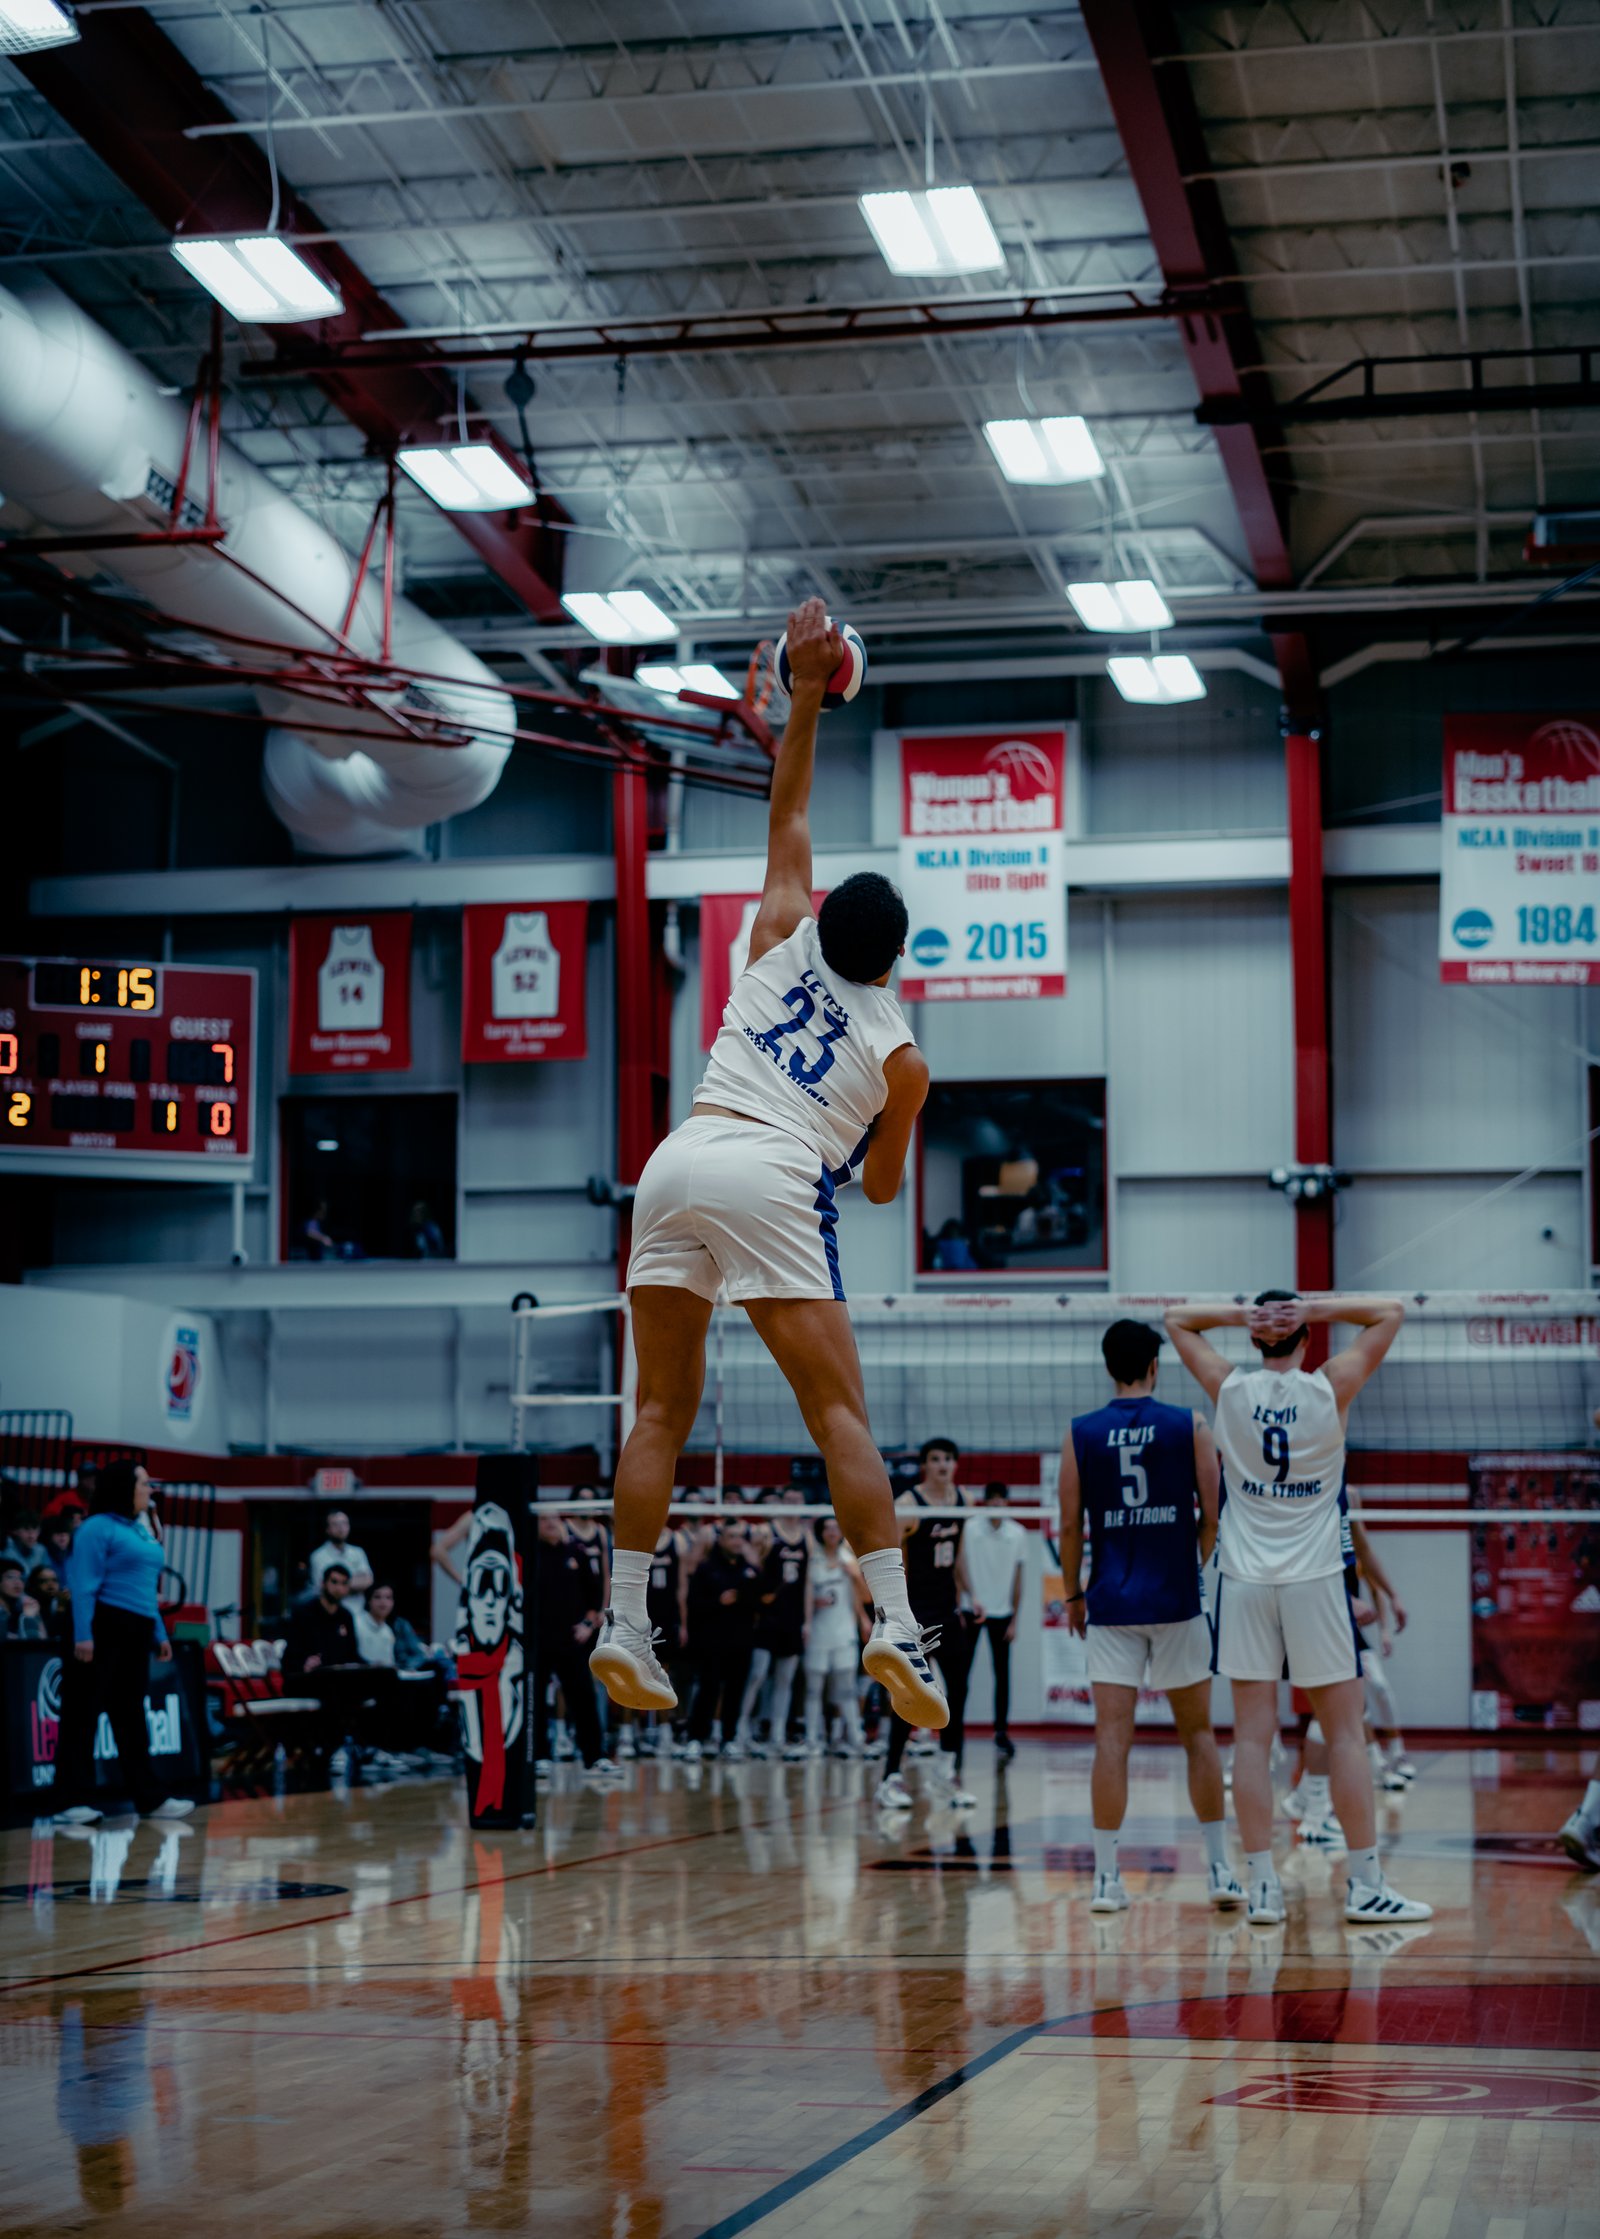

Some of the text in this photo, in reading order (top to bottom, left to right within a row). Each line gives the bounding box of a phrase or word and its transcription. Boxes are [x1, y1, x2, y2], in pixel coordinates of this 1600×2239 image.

[1454, 775, 1600, 811] Basketbal
[910, 792, 1054, 832] Basketball
[1458, 828, 1506, 848] NCAA
[1514, 828, 1582, 848] Division
[916, 850, 960, 869] NCAA
[967, 848, 1031, 867] Division
[1516, 853, 1575, 874] Sweet
[1008, 871, 1047, 891] Eight
[1516, 904, 1597, 944] 1984
[966, 921, 1047, 961] 2015
[80, 967, 155, 1010] 1:15
[762, 987, 848, 1084] 23
[95, 1044, 105, 1073] 1
[211, 1043, 233, 1083] 7
[8, 1092, 31, 1127] 2
[166, 1101, 177, 1132] 1
[210, 1102, 232, 1135] 0
[1253, 1405, 1297, 1424] LEWIS
[1107, 1425, 1156, 1447] LEWIS
[1263, 1426, 1289, 1482] 9
[1119, 1445, 1148, 1508] 5
[1272, 1480, 1322, 1498] STRONG
[1129, 1506, 1177, 1526] STRONG
